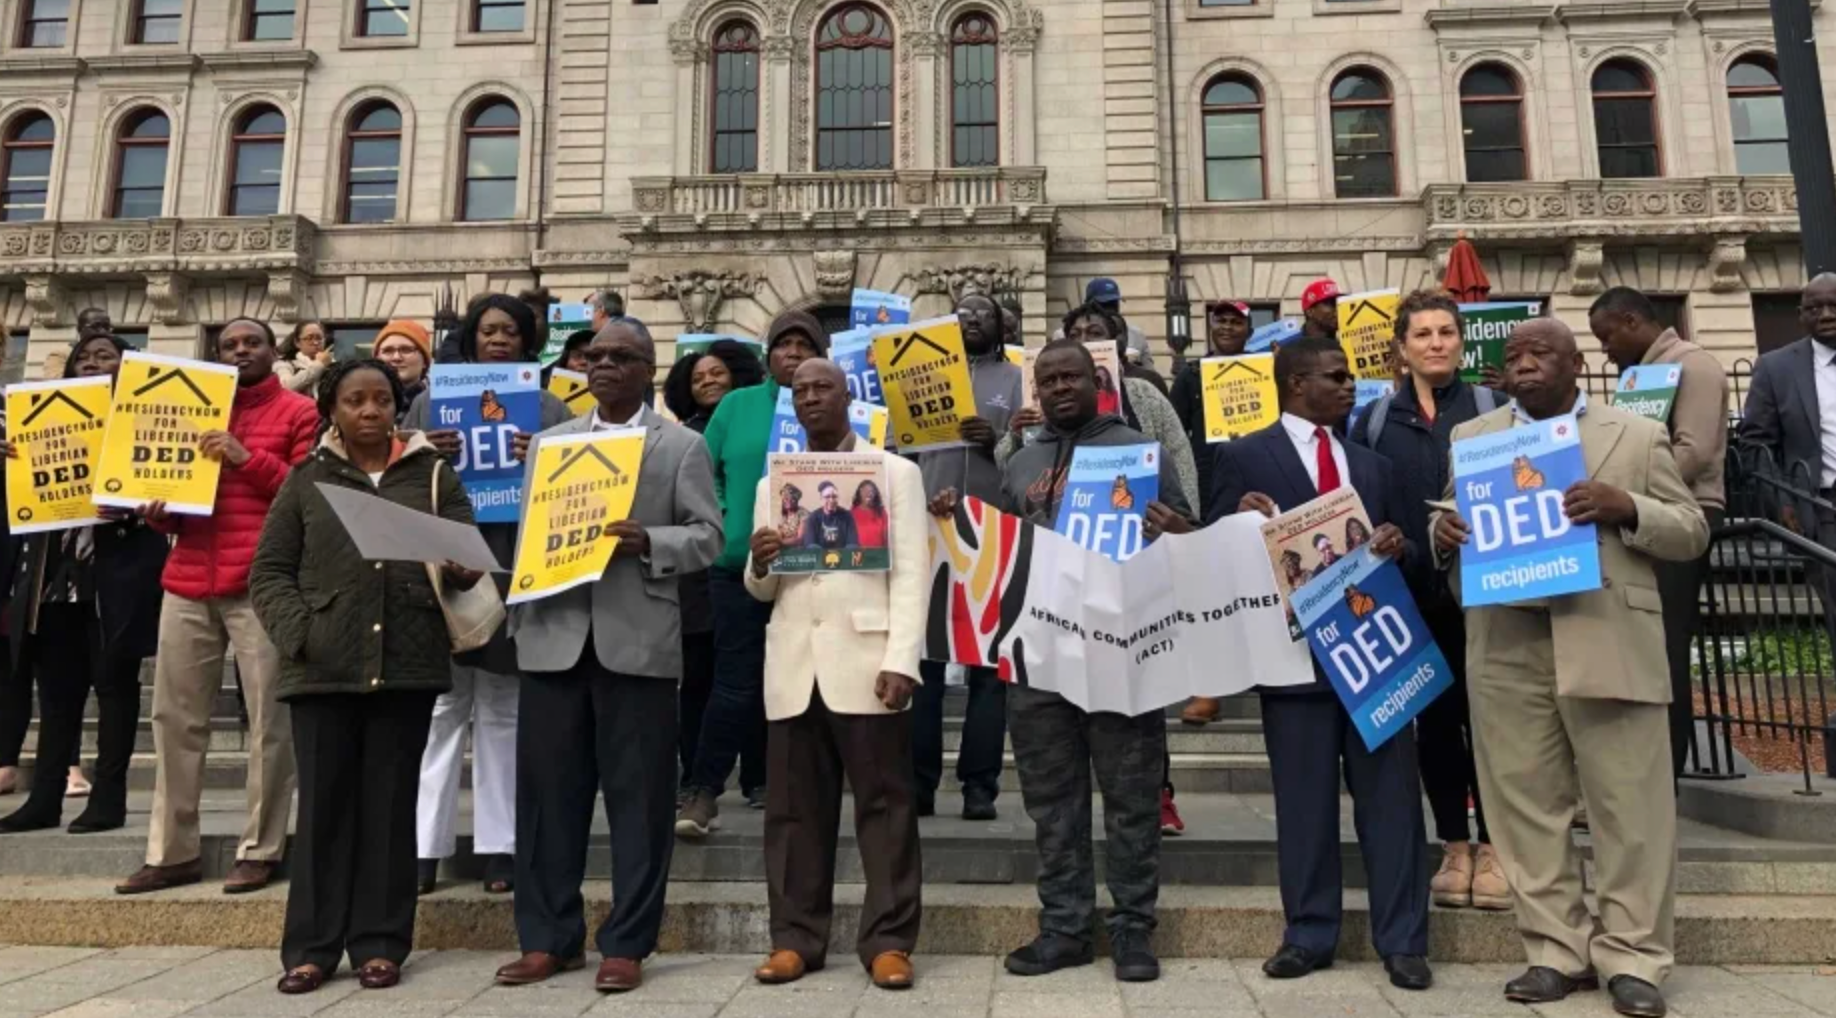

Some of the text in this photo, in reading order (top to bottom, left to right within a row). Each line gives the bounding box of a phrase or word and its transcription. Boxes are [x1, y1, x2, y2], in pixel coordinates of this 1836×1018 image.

[883, 354, 959, 383] #RESIDENCYNOW
[435, 372, 509, 387] #ResidencyNow
[913, 375, 931, 386] FOR
[904, 381, 951, 401] LIBERIAN
[116, 403, 221, 418] #RESIDENCYNOW
[440, 405, 463, 424] for
[908, 396, 955, 418] DED
[1222, 401, 1262, 417] DED
[11, 418, 104, 444] #RESIDENCYNOW
[154, 417, 177, 429] FOR
[780, 420, 800, 435] for
[916, 413, 959, 429] HOLDERS
[46, 438, 67, 450] FOR
[135, 430, 199, 443] LIBERIAN
[32, 447, 89, 467] LIBERIAN
[132, 446, 196, 464] DED
[1458, 433, 1541, 464] #ResidencyNow
[1075, 455, 1138, 471] #ResidencyNow
[33, 463, 90, 488] DED
[134, 468, 193, 480] HOLDERS
[39, 484, 93, 503] HOLDERS
[533, 474, 630, 504] #RESIDENCYNOW
[1072, 488, 1095, 507] for
[1466, 480, 1494, 501] for
[566, 496, 587, 511] FOR
[549, 506, 608, 530] LIBERIAN
[1471, 489, 1571, 553] DED
[545, 524, 603, 553] DED
[1065, 512, 1144, 561] DED
[546, 545, 595, 569] HOLDERS
[1481, 555, 1580, 591] recipients
[1298, 559, 1360, 615] #ResidencyNow
[1093, 609, 1196, 649] COMMUNITIES
[1316, 620, 1342, 648] for
[1135, 637, 1174, 666] (ACT)
[1330, 604, 1413, 695] DED
[1369, 662, 1435, 729] recipients
